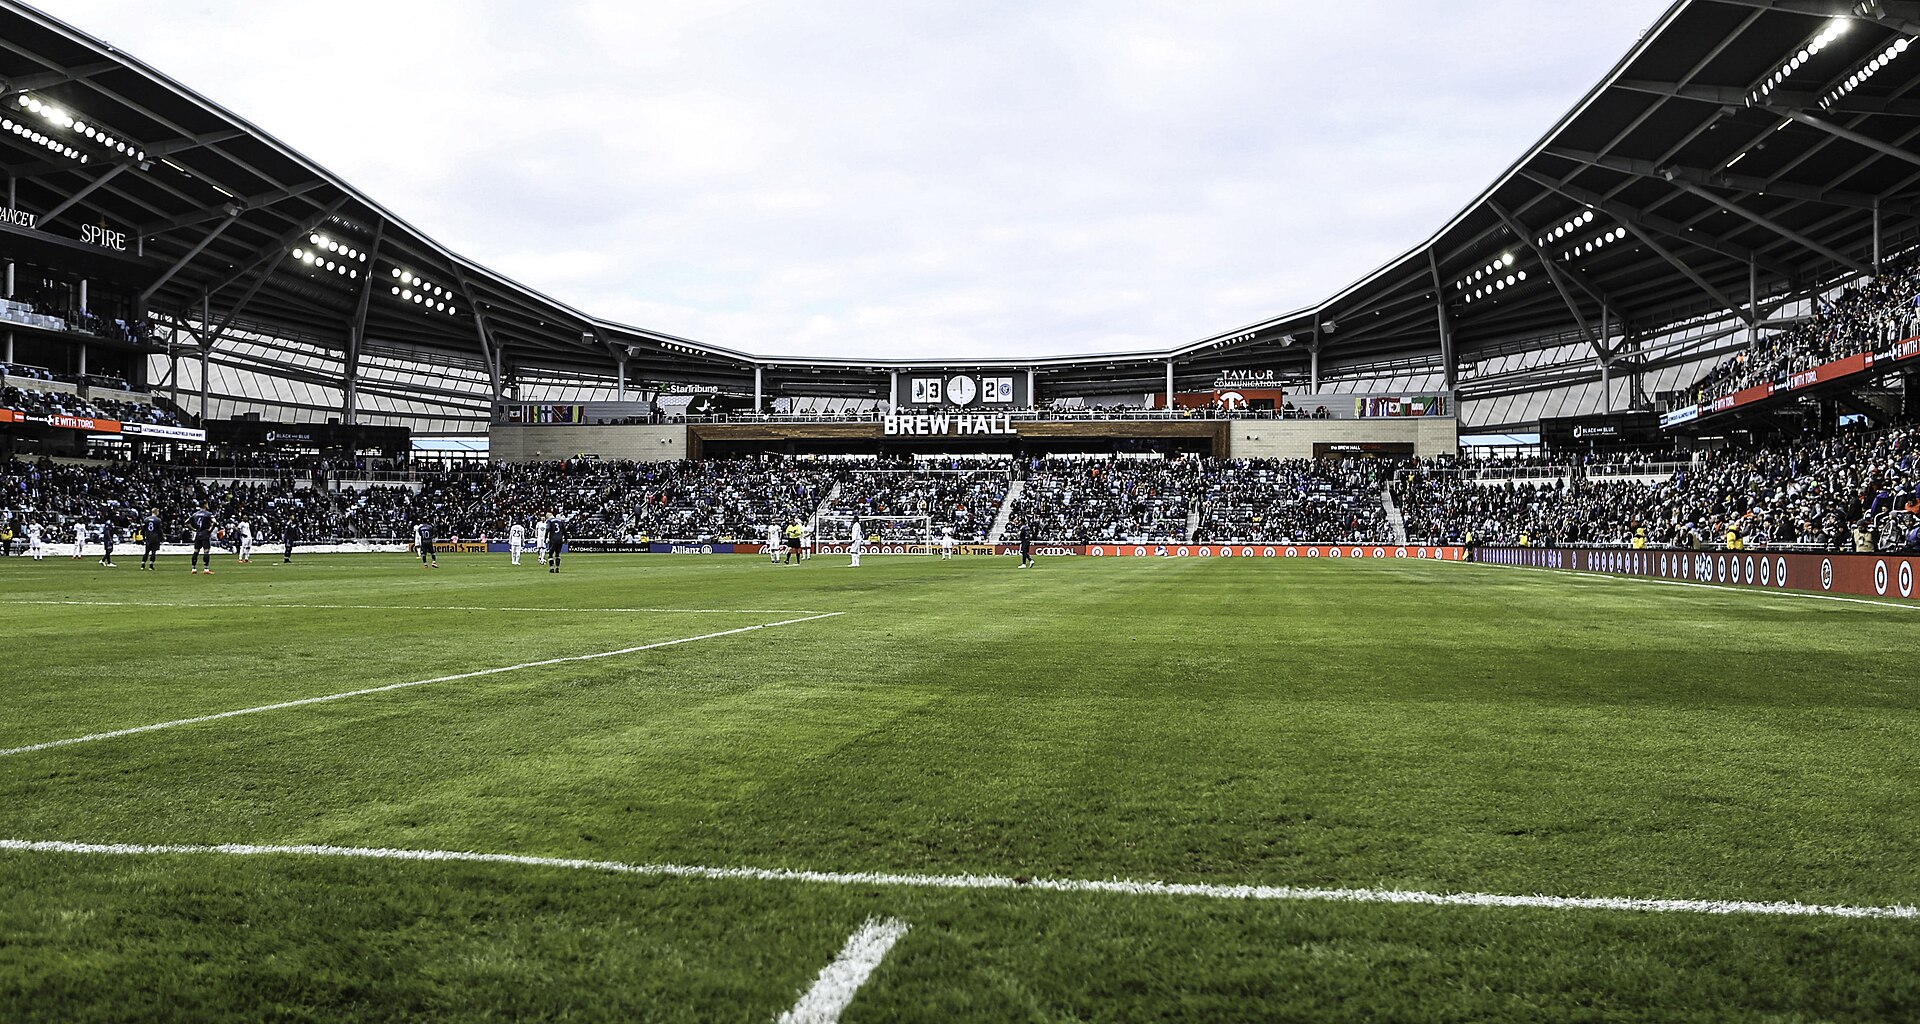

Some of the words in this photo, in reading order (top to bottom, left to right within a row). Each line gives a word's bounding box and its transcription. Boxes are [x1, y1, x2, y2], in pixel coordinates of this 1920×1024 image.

[0, 207, 29, 227] ANCE
[80, 223, 126, 252] SPIRE
[1222, 370, 1274, 379] TAYLOR
[1213, 380, 1282, 388] COMMUNICATIONS
[670, 385, 718, 393] StarTribune
[929, 382, 939, 399] 3
[985, 382, 995, 398] 2
[60, 417, 76, 427] WITH
[884, 415, 950, 435] BREW
[957, 415, 1017, 435] HALL
[147, 522, 154, 531] 8
[554, 523, 560, 533] 3
[421, 530, 430, 538] 10
[513, 529, 521, 537] 25
[671, 545, 700, 554] Allianz
